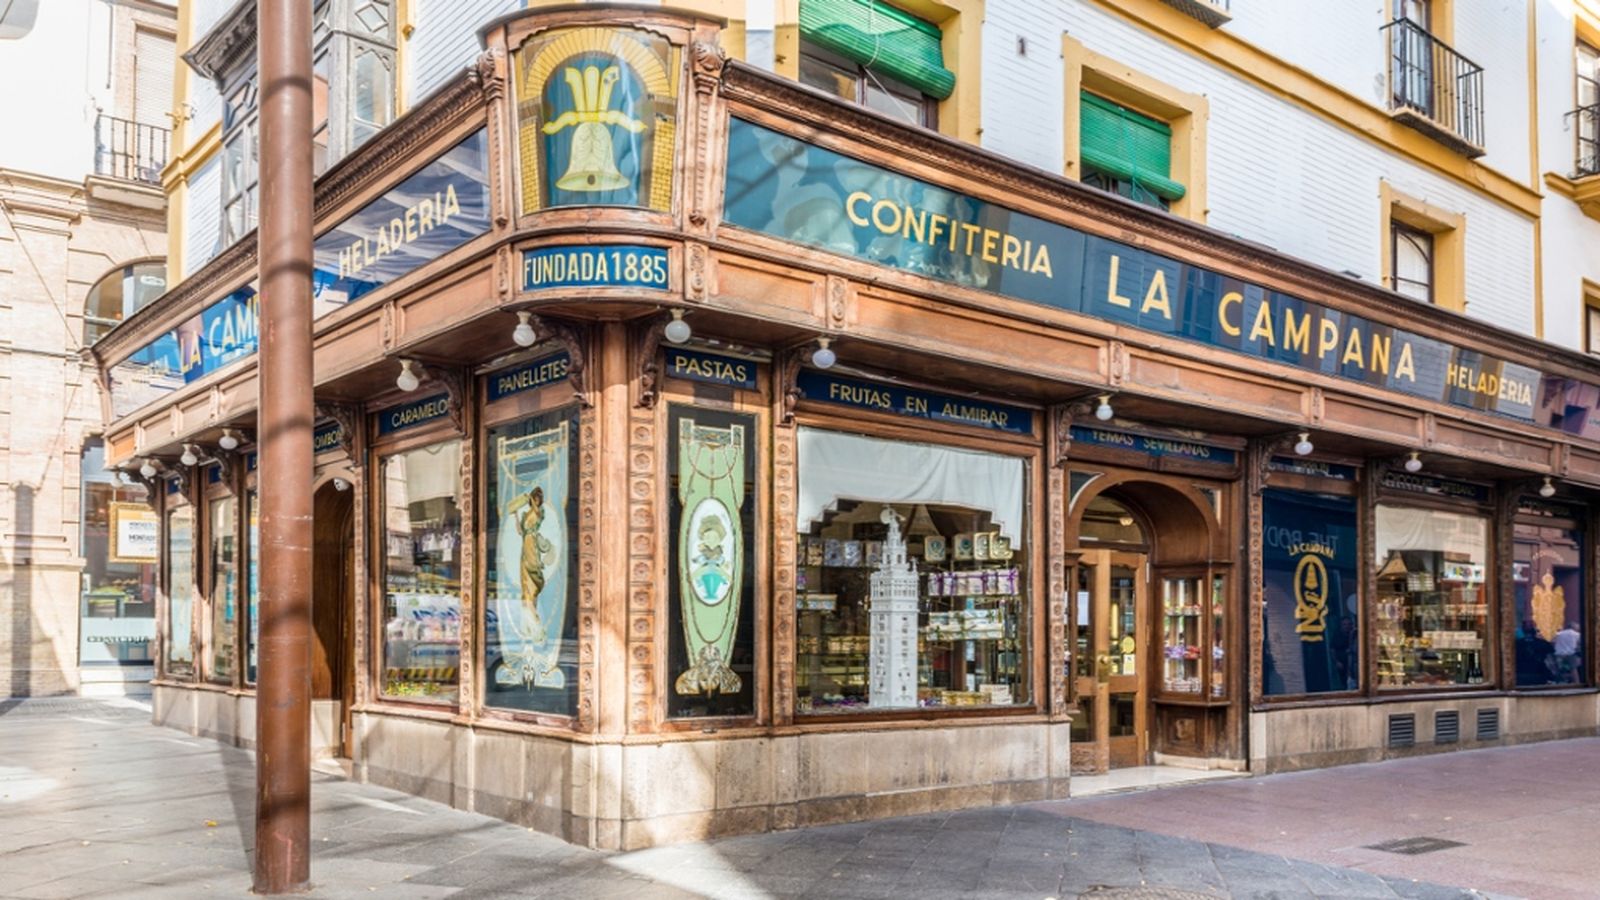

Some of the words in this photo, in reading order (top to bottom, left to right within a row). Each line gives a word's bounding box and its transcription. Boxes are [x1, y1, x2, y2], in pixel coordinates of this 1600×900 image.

[181, 330, 202, 374] LA
[338, 183, 461, 280] HELADERIA
[524, 252, 609, 287] FUNDADA
[611, 251, 667, 284] 1885
[845, 191, 1053, 279] CONFITERIA
[1107, 254, 1172, 321] LA
[1219, 291, 1416, 383] CAMPANA
[1446, 362, 1532, 407] HELADERIA
[498, 358, 568, 395] PANELLETES
[675, 355, 747, 382] PASTAS
[829, 383, 891, 409] FRUTAS
[904, 396, 928, 413] EN
[941, 403, 1008, 427] ALMIBAR
